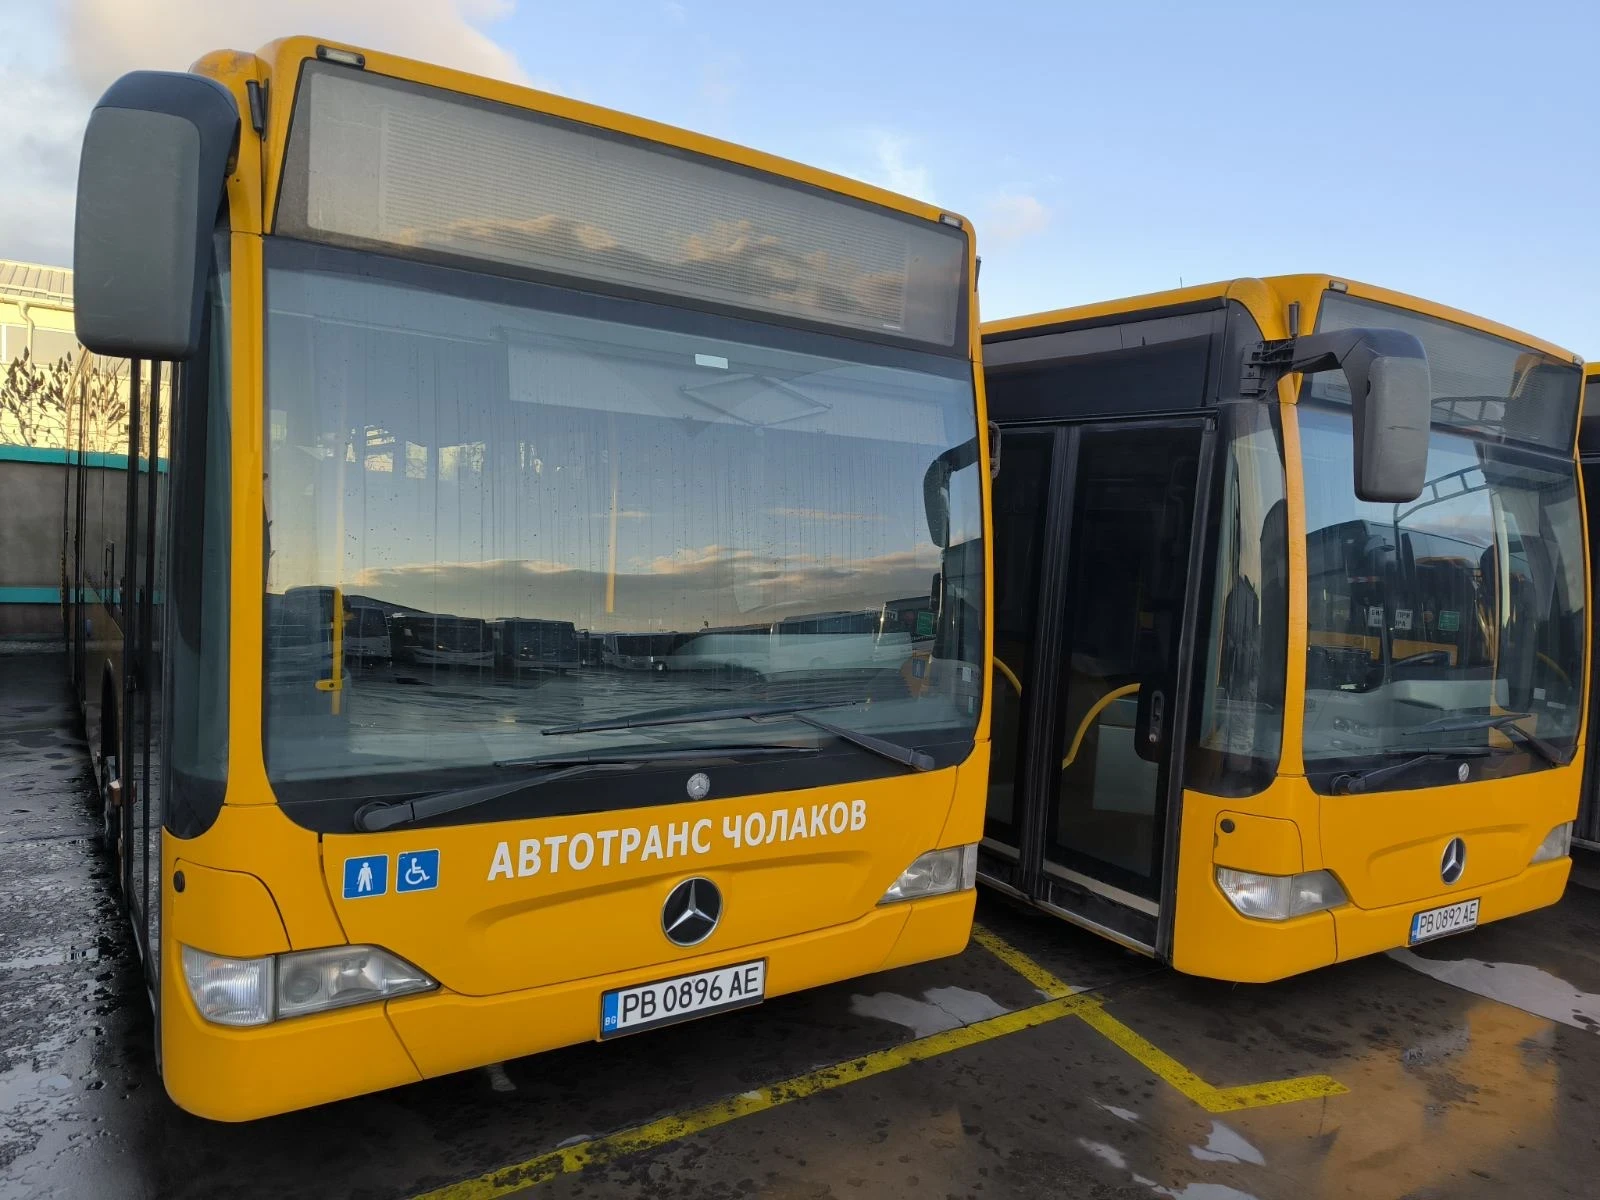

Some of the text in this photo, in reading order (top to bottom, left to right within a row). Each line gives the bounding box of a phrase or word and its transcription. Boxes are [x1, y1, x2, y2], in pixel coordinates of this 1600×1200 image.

[487, 799, 867, 881] АВТОТРАНС ЧОЛАКОВ
[1419, 903, 1477, 935] PB 0892 AE
[622, 966, 759, 1023] PB 0896 AE
[604, 1015, 617, 1026] BG
